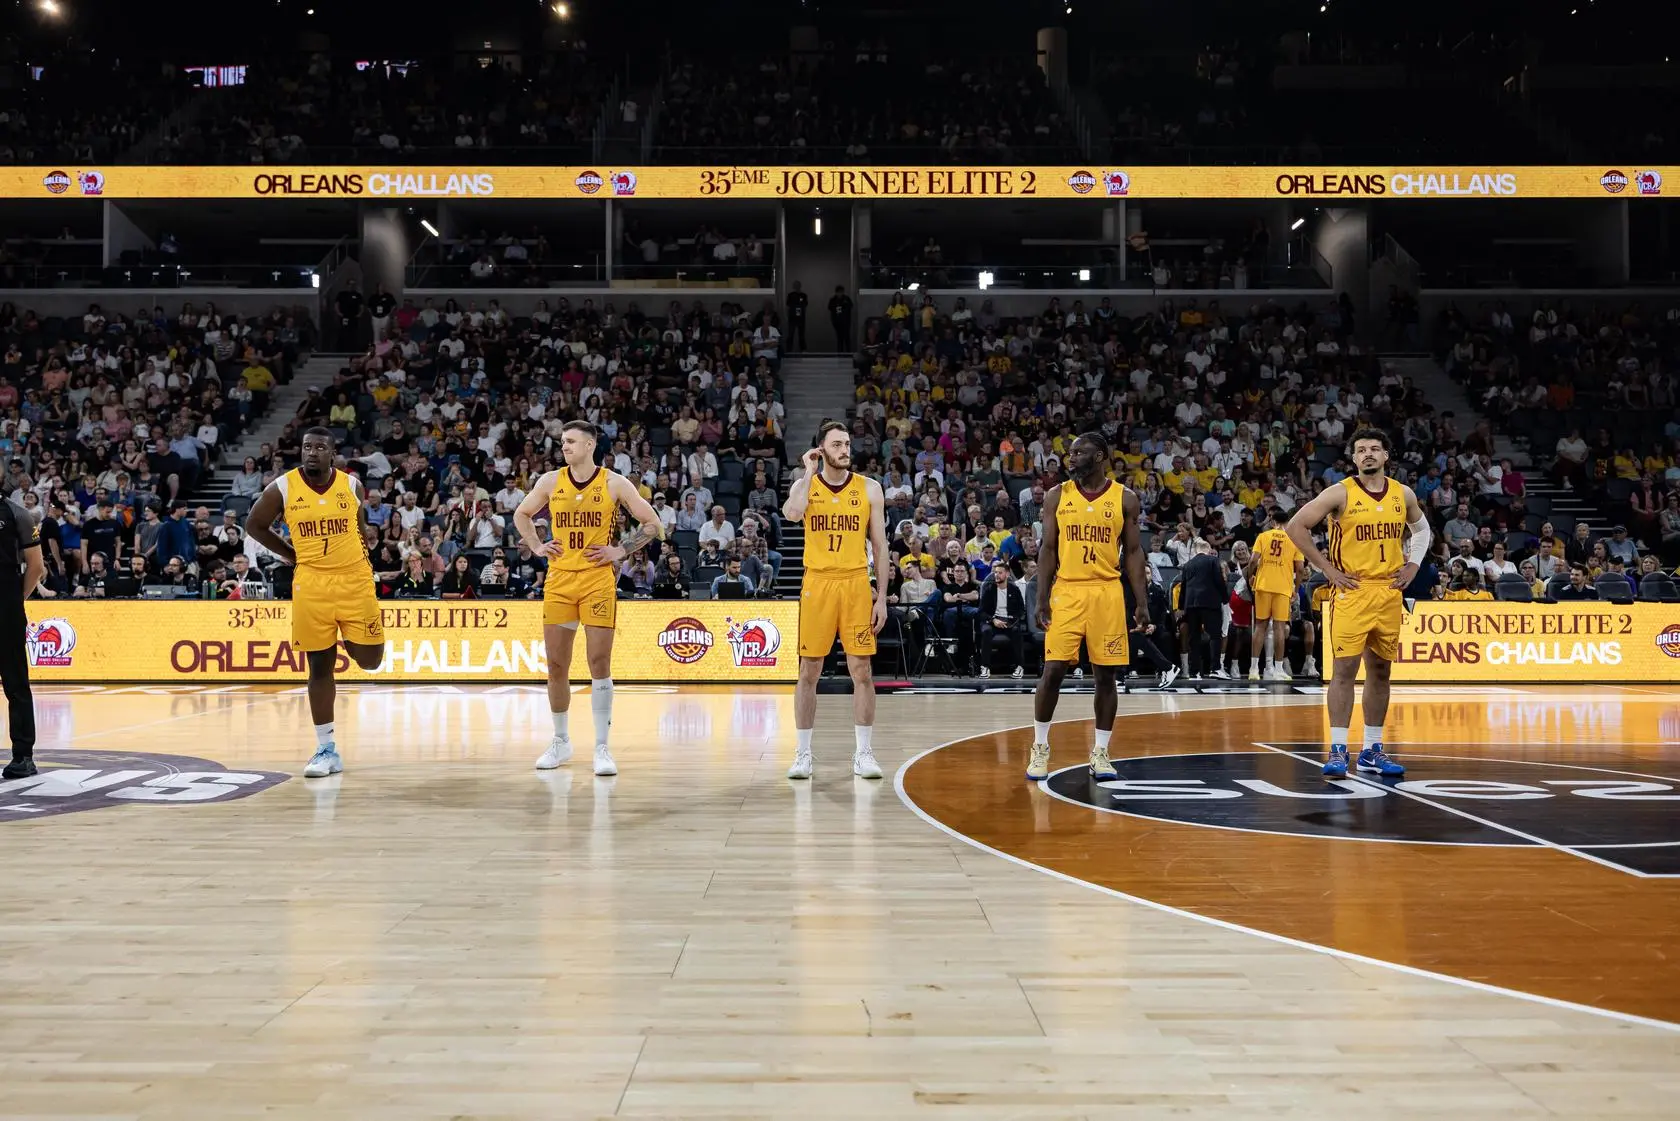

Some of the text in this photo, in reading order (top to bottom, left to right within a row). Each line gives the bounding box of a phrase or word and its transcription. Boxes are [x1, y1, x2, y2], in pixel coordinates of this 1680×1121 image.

[254, 173, 494, 195] ORLEANS CHALLANS
[700, 166, 1036, 195] 35ÈME JOURNEE ELITE 2
[1276, 173, 1517, 195] ORLEANS CHALLANS
[298, 517, 349, 538] ORLÉANS
[556, 509, 602, 528] ORLÉANS
[811, 512, 859, 532] ORLÉANS
[569, 531, 585, 550] 88
[1066, 523, 1111, 544] ORLÉANS
[1356, 520, 1402, 542] ORLÉANS
[321, 538, 329, 556] 7
[828, 534, 843, 552] 17
[1270, 539, 1284, 557] 95
[1082, 545, 1097, 564] 24
[1379, 544, 1386, 563] 1
[416, 608, 489, 628] ELITE
[494, 608, 508, 628] 2
[1414, 614, 1535, 635] JOURNEE
[1540, 614, 1614, 635] ELITE
[1618, 613, 1634, 634] 2
[1485, 640, 1624, 665] CHALLANS
